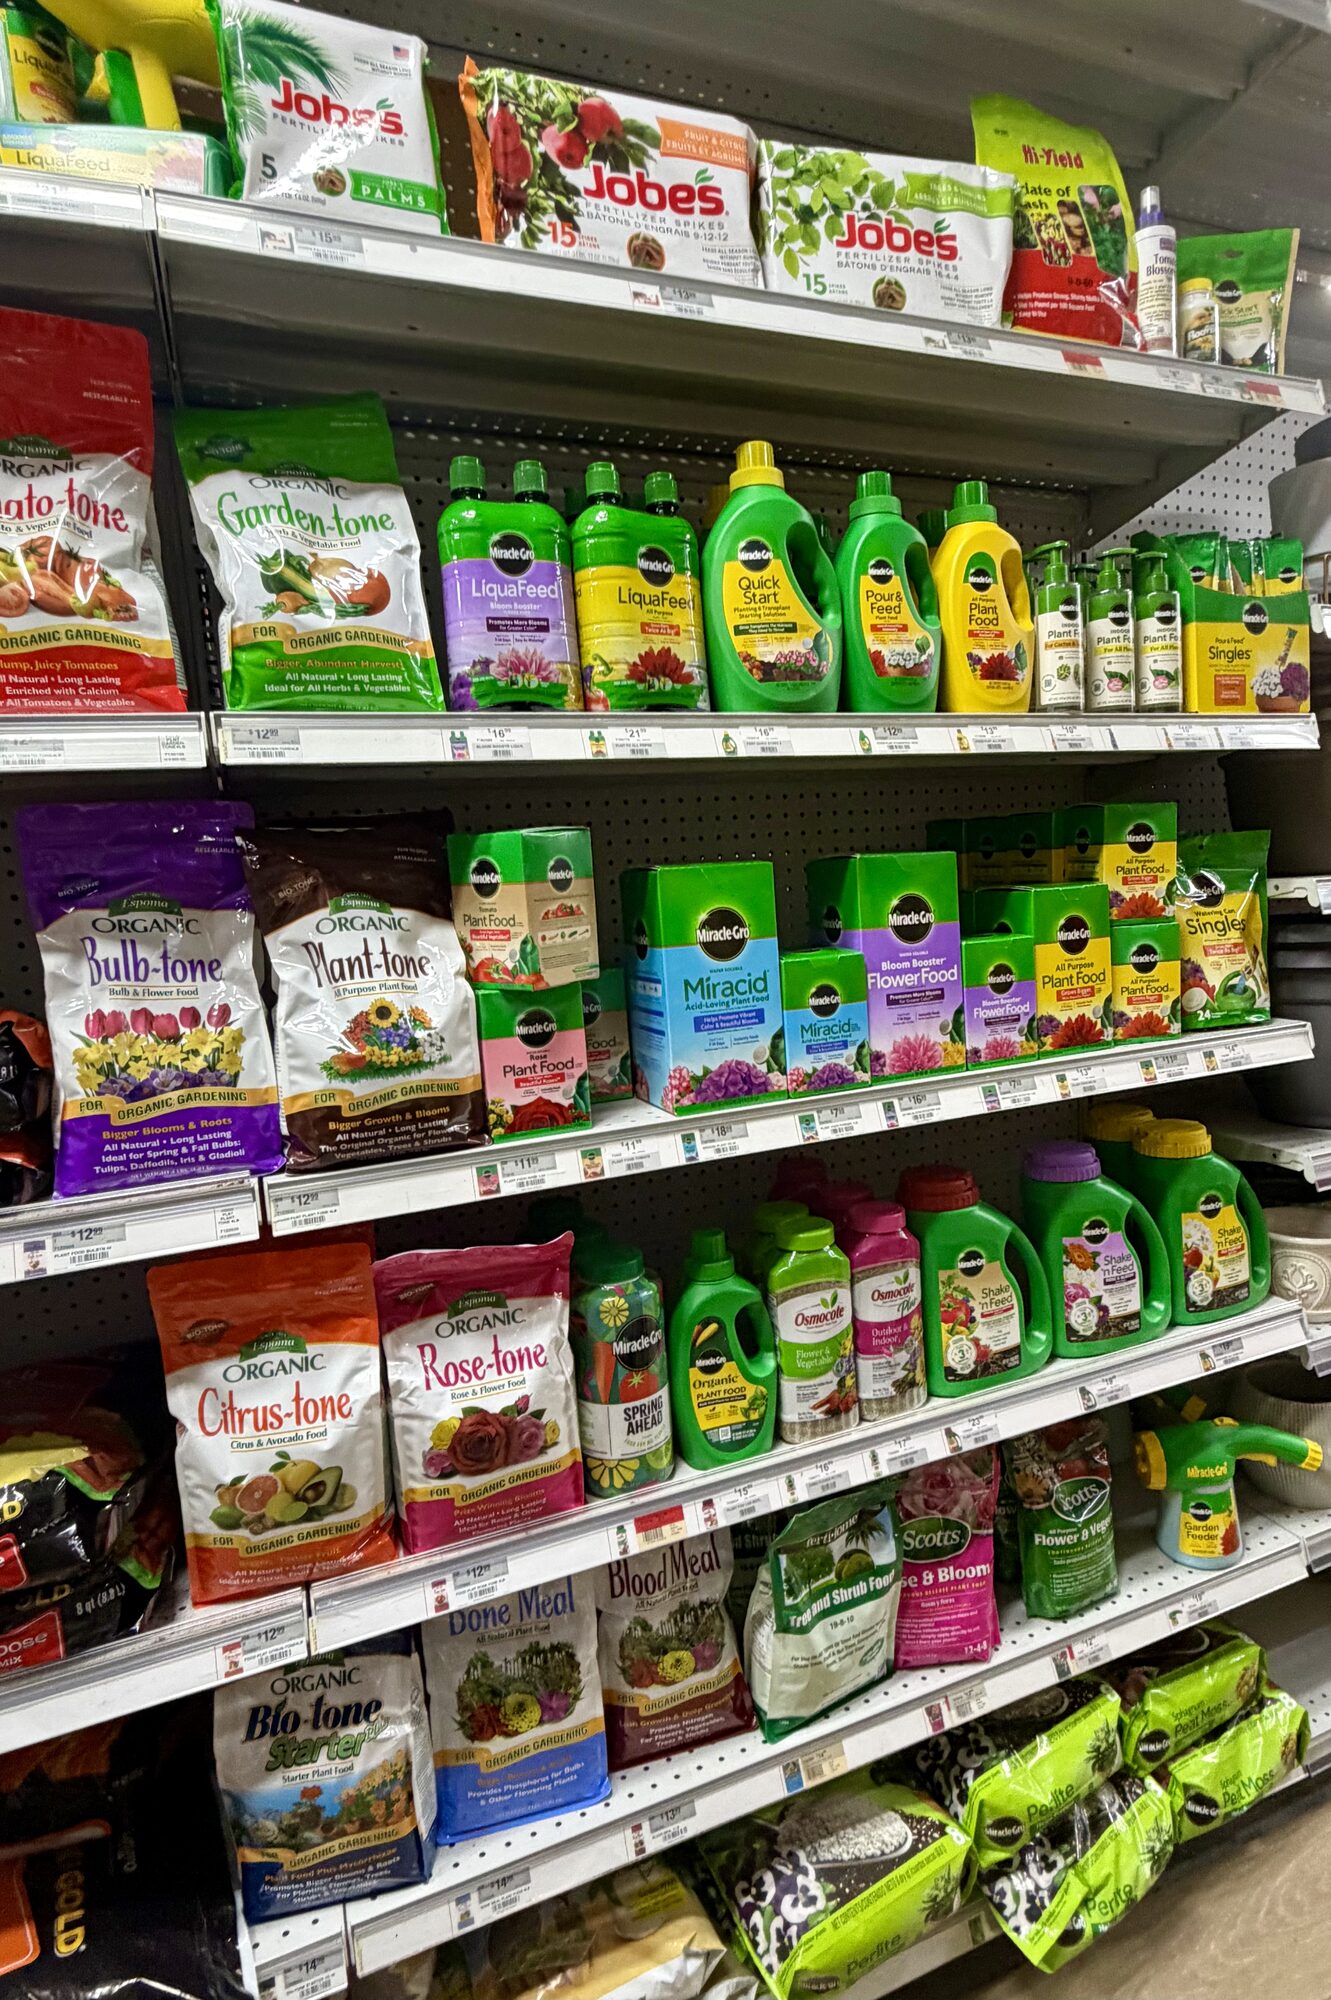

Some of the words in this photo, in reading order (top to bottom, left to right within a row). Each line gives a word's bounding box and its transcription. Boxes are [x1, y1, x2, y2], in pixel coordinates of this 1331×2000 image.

[1022, 144, 1084, 169] Hi-Yield
[361, 185, 426, 208] PALMS
[585, 201, 667, 225] FERTILIZER
[675, 219, 726, 231] SPIKES
[547, 221, 576, 247] 15
[837, 251, 910, 264] FERTILIZER
[918, 258, 958, 272] SPIKES
[803, 273, 828, 295] 15
[249, 477, 351, 500] ORGANIC
[218, 491, 395, 538] Garden-tone
[471, 578, 559, 600] LiquaFeed
[738, 575, 780, 592] Quick
[618, 586, 696, 611] LiquaFeed
[743, 591, 779, 605] Start
[870, 602, 901, 615] Feed
[969, 602, 998, 616] Plant
[968, 615, 999, 627] Food
[1, 628, 61, 649] ORGANIC
[65, 628, 142, 650] GARDENING
[253, 626, 277, 639] FOR
[290, 630, 343, 649] ORGANIC
[346, 630, 408, 649] GARDENING
[1048, 629, 1072, 639] Plant
[1209, 646, 1250, 663] Singles
[6, 686, 51, 696] Enriched
[54, 686, 76, 696] with
[79, 686, 119, 696] Calcium
[6, 698, 21, 707] All
[22, 698, 73, 707] Tomatoes
[74, 698, 81, 707] &
[83, 698, 135, 708] Vegetables
[1116, 865, 1139, 875] Plant
[1141, 863, 1164, 874] Food
[92, 917, 202, 935] ORGANIC
[316, 916, 411, 935] ORGANIC
[463, 914, 486, 928] Plant
[488, 915, 516, 927] Food
[1186, 916, 1246, 935] Singles
[696, 927, 750, 945] Miracle-Gro
[81, 935, 223, 988] Bulb-tone
[302, 936, 430, 989] Plant-tone
[882, 960, 910, 971] Bloom
[912, 957, 945, 968] Booster
[1056, 962, 1066, 971] All
[1067, 961, 1094, 971] Purpose
[684, 972, 769, 1002] Miracid
[867, 972, 920, 990] Flower
[921, 965, 958, 983] Food
[1042, 972, 1074, 989] Plant
[1076, 968, 1106, 985] Food
[109, 987, 129, 997] Bulb
[132, 988, 140, 997] &
[143, 988, 173, 997] Flower
[176, 987, 199, 997] Food
[1121, 984, 1144, 995] Plant
[1146, 983, 1169, 994] Food
[685, 1000, 730, 1012] Acid-Loving
[731, 997, 750, 1007] Plant
[752, 995, 770, 1003] Food
[973, 1005, 1004, 1018] Flower
[1006, 1002, 1030, 1014] Food
[1197, 1010, 1211, 1021] 24
[801, 1020, 851, 1037] Miracid
[503, 1063, 538, 1076] Plant
[540, 1060, 574, 1072] Food
[79, 1100, 104, 1113] FOR
[118, 1098, 174, 1121] ORGANIC
[177, 1089, 247, 1105] GARDENING
[314, 1092, 336, 1104] FOR
[348, 1090, 398, 1112] ORGANIC
[401, 1081, 460, 1096] GARDENING
[102, 1129, 139, 1140] Bigger
[142, 1124, 184, 1136] Blooms
[188, 1121, 196, 1129] &
[200, 1118, 232, 1128] Roots
[329, 1120, 361, 1132] Bigger
[364, 1116, 402, 1127] Growth
[405, 1113, 413, 1121] &
[416, 1106, 450, 1118] Blooms
[103, 1144, 118, 1152] All
[121, 1139, 160, 1151] Natural
[170, 1136, 194, 1145] Long
[197, 1130, 232, 1141] Lasting
[335, 1132, 349, 1142] All
[351, 1129, 387, 1140] Natural
[393, 1124, 417, 1134] Long
[419, 1119, 448, 1132] Lasting
[94, 1164, 127, 1174] Tulips,
[130, 1158, 177, 1170] Daffodils,
[209, 1149, 245, 1160] Gladioli
[102, 1154, 126, 1163] Ideal
[129, 1152, 143, 1160] for
[147, 1148, 178, 1159] Spring
[181, 1146, 189, 1154] &
[192, 1144, 209, 1152] Fall
[212, 1140, 241, 1149] Bulbs:
[1218, 1226, 1242, 1239] Shake
[1103, 1252, 1132, 1267] Shake
[871, 1282, 914, 1301] Osmocote
[981, 1284, 1010, 1299] Shake
[435, 1308, 526, 1339] ORGANIC
[795, 1306, 845, 1327] Osmocote
[613, 1329, 662, 1356] Miracle-Gro
[222, 1354, 326, 1383] ORGANIC
[417, 1335, 548, 1392] Rose-tone
[451, 1391, 469, 1401] Rose
[471, 1389, 478, 1397] &
[480, 1382, 506, 1397] Flower
[508, 1378, 526, 1389] Food
[692, 1374, 738, 1390] Organic
[696, 1391, 718, 1400] PLANT
[720, 1386, 746, 1396] FOOD
[198, 1381, 352, 1438] Citrus-tone
[624, 1396, 664, 1421] SPRING
[627, 1414, 663, 1436] AHEAD
[231, 1439, 254, 1449] Citrus
[256, 1438, 264, 1447] &
[266, 1433, 304, 1447] Avocado
[305, 1428, 327, 1439] Food
[1187, 1462, 1227, 1478] Miracle-Gro
[430, 1487, 450, 1498] FOR
[460, 1480, 505, 1502] ORGANIC
[508, 1461, 561, 1485] GARDENING
[1058, 1482, 1100, 1514] Scotts
[213, 1536, 234, 1546] FOR
[245, 1533, 294, 1555] ORGANIC
[297, 1520, 360, 1542] GARDENING
[903, 1526, 963, 1550] Scotts
[1185, 1522, 1219, 1532] Garden
[1187, 1531, 1218, 1541] Feeder
[608, 1558, 670, 1600] Blood
[670, 1533, 721, 1578] Meal
[789, 1606, 812, 1628] Tree
[811, 1598, 830, 1618] and
[832, 1583, 867, 1607] Shrub
[869, 1569, 895, 1591] Food
[271, 1666, 362, 1696] ORGANIC
[1174, 1716, 1200, 1738] Peat
[1202, 1702, 1228, 1724] Moss
[282, 1773, 311, 1785] Starter
[312, 1768, 332, 1779] Plant
[334, 1763, 354, 1775] Food
[1245, 1770, 1275, 1800] Moss
[1028, 1784, 1074, 1822] Perlite
[1084, 1883, 1133, 1918] Perlite
[846, 1936, 901, 1977] Perlite
